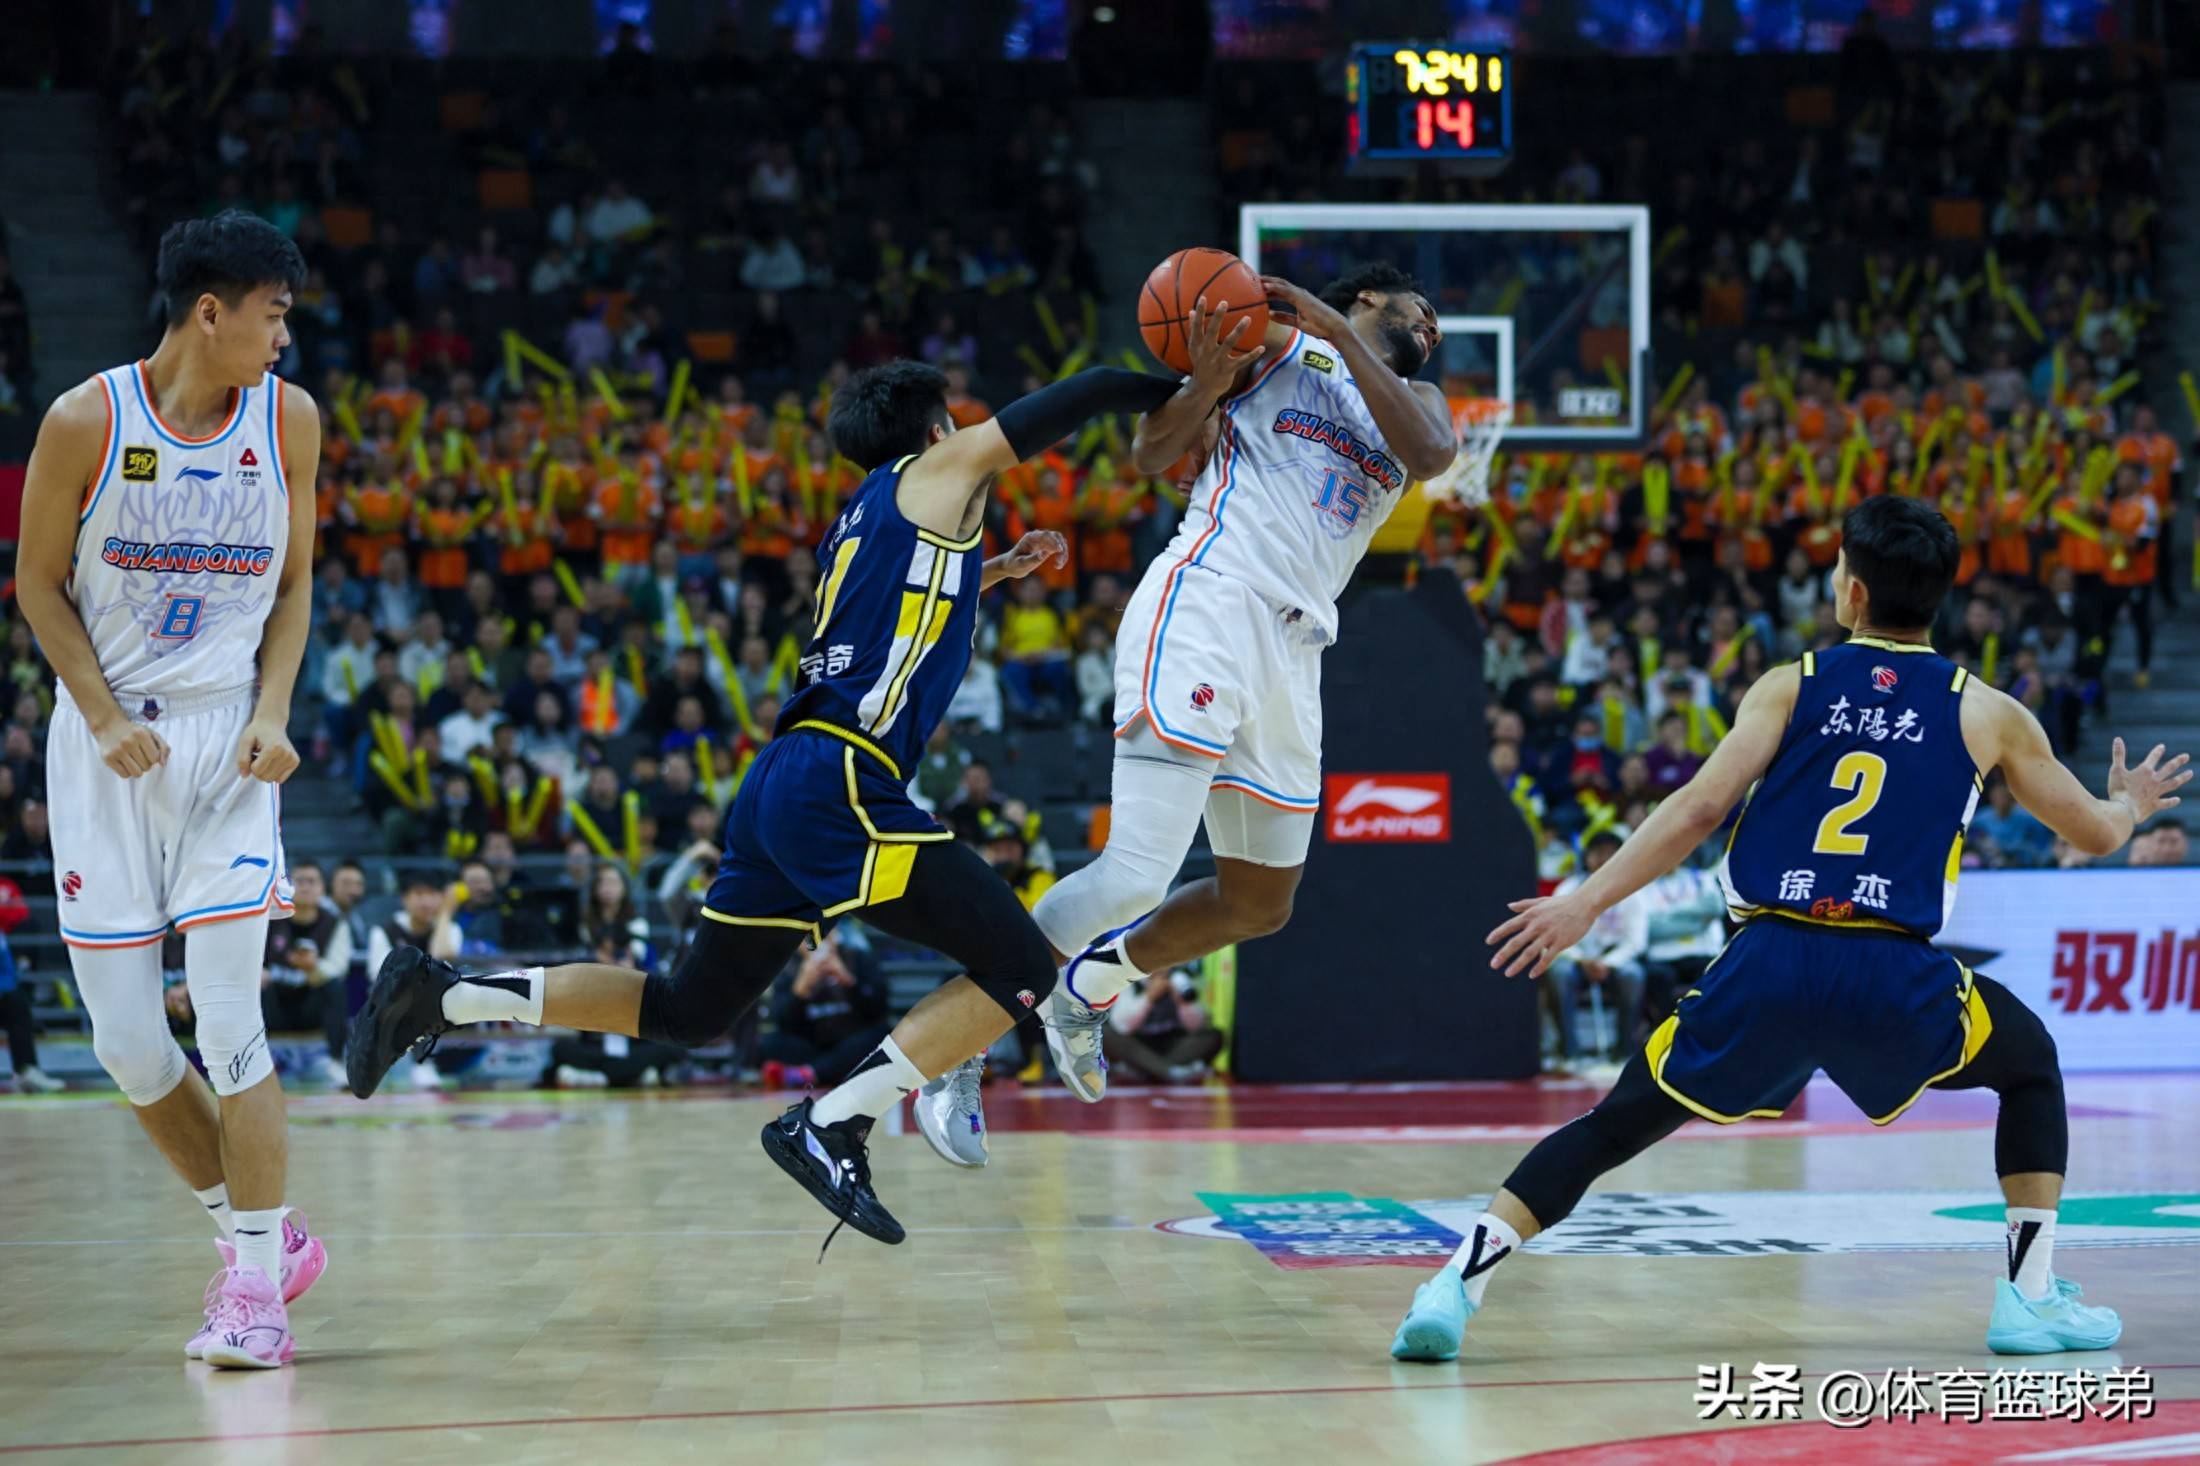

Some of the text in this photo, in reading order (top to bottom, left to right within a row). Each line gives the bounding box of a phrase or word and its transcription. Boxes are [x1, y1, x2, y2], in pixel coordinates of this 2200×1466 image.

[1417, 101, 1474, 149] 14
[1312, 467, 1368, 528] 15
[101, 537, 274, 577] SHANDONG
[151, 593, 206, 640] 8
[1812, 751, 1888, 856] 2
